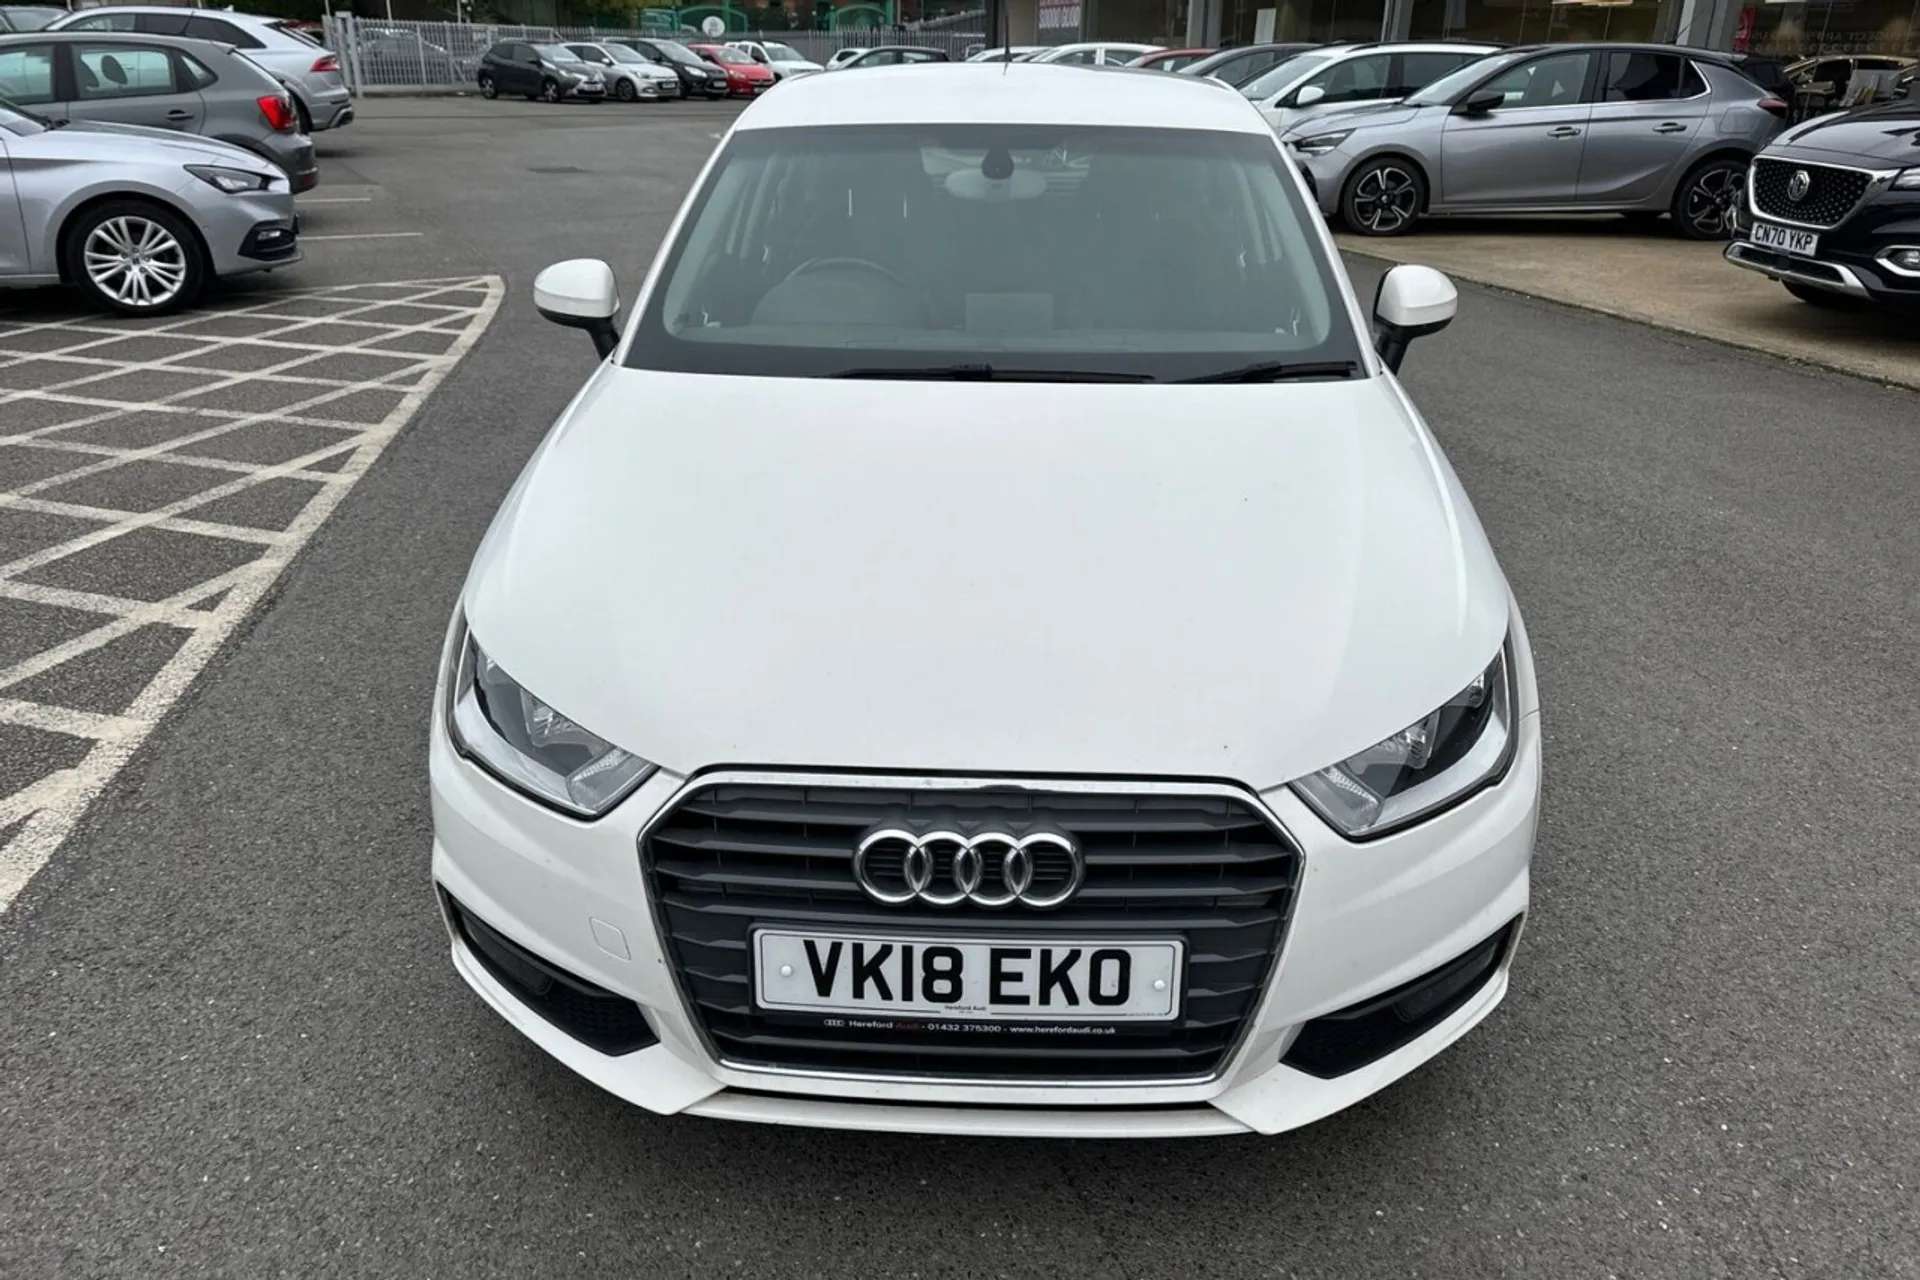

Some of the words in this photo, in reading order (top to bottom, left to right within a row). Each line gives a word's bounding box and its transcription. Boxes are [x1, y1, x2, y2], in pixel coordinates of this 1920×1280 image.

[1755, 225, 1786, 246] CN70
[1789, 230, 1813, 251] YKP
[803, 940, 963, 1004] VK18
[989, 947, 1131, 1006] EKO
[849, 1020, 893, 1029] Hereford
[927, 1023, 960, 1031] 01432
[962, 1024, 1001, 1032] 375300
[1010, 1025, 1116, 1034] www.herefordaudi.co.uk
